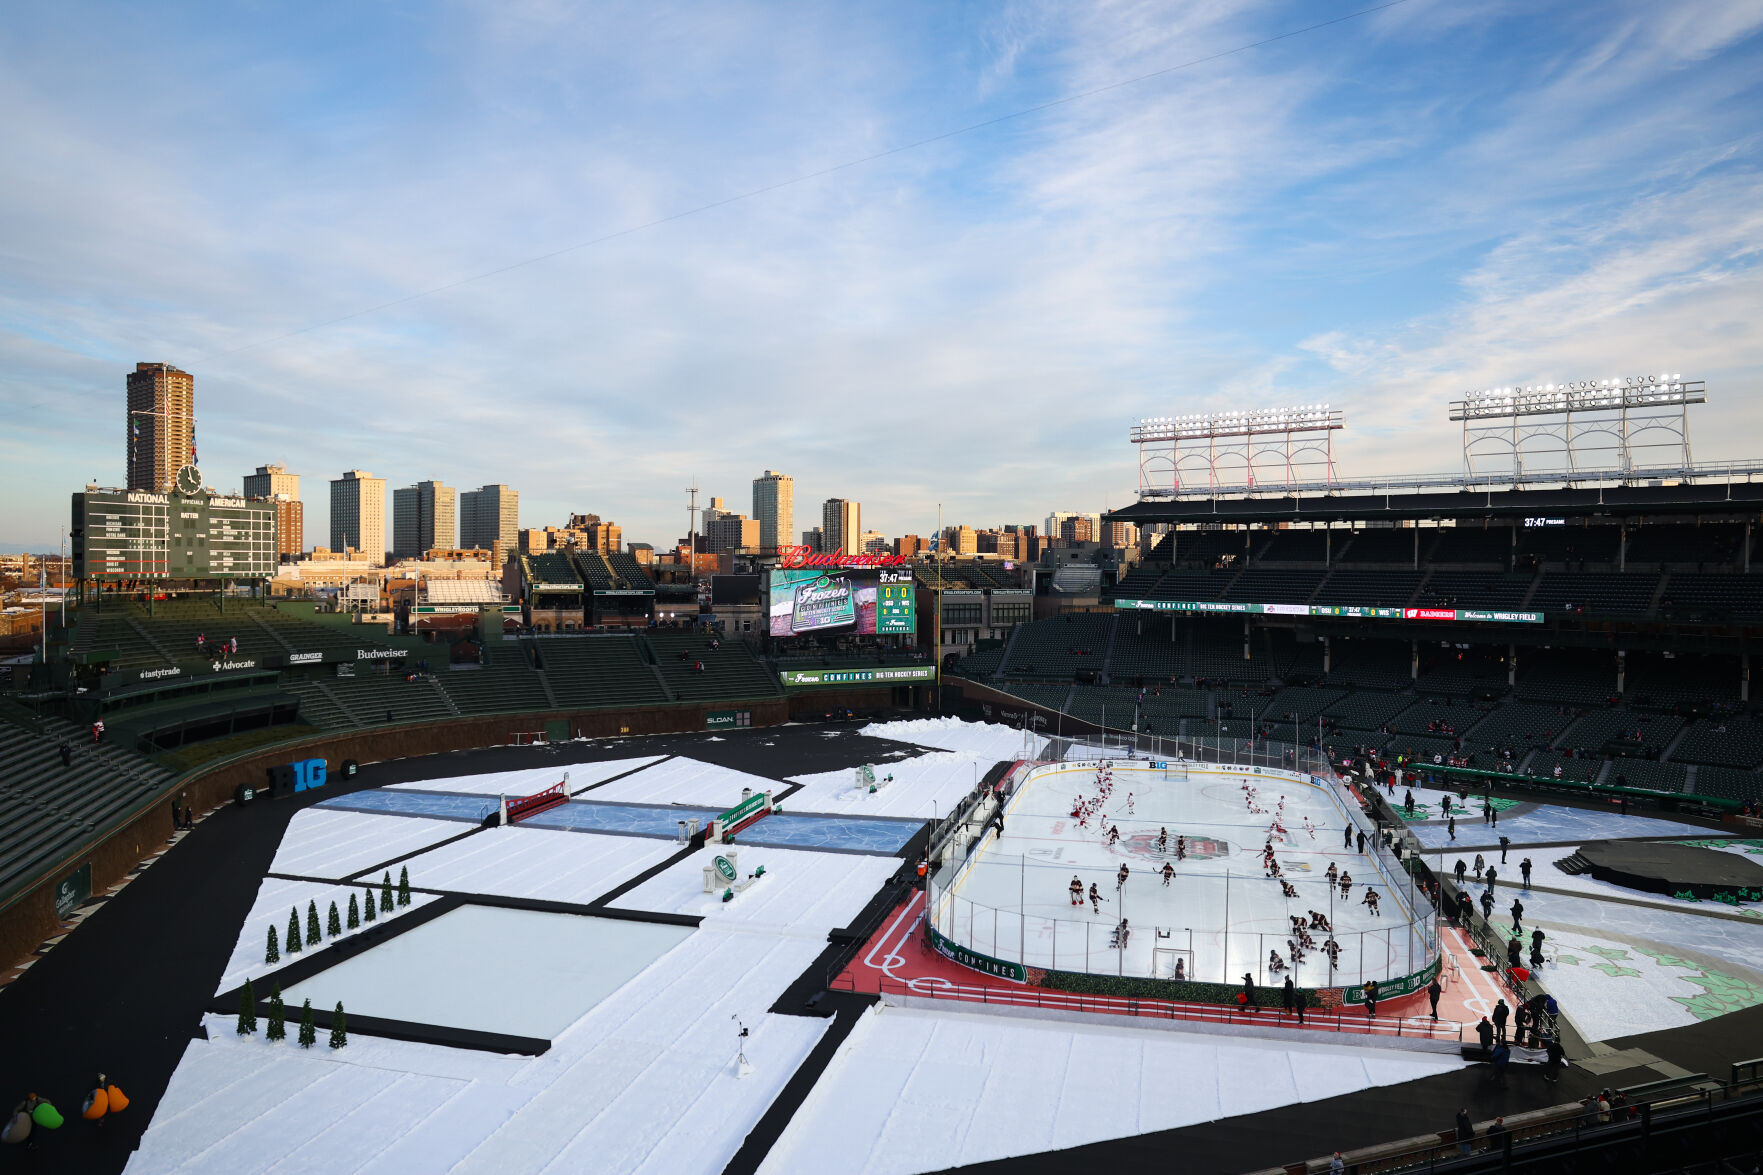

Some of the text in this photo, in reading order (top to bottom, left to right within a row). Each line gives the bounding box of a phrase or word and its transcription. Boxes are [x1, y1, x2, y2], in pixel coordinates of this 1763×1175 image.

[127, 493, 170, 504] NATIONAL
[209, 497, 246, 508] AMERICAN
[1524, 517, 1546, 527] 37:47
[777, 544, 907, 569] Budweiser
[880, 573, 898, 583] 37:47
[798, 587, 849, 604] Frozen
[885, 587, 891, 598] 0
[901, 587, 907, 598] 0
[800, 599, 848, 612] CONFINES
[1157, 602, 1196, 610] CONFINES
[1334, 607, 1340, 615] 0
[1420, 610, 1454, 618] BADGERS
[1464, 611, 1486, 619] Welcome
[1493, 612, 1519, 620] WRIGLEY
[1519, 613, 1537, 621] FIELD
[289, 652, 324, 661] GRAINGER
[356, 648, 409, 660] Budweiser
[222, 660, 255, 670] Advocate
[144, 666, 181, 679] tastytrade
[794, 673, 820, 683] Frozen
[823, 672, 873, 682] CONFINES
[875, 671, 884, 679] BIG
[894, 670, 912, 678] HOCKEY
[706, 716, 733, 724] SLOAN
[1394, 982, 1405, 990] FIELD
